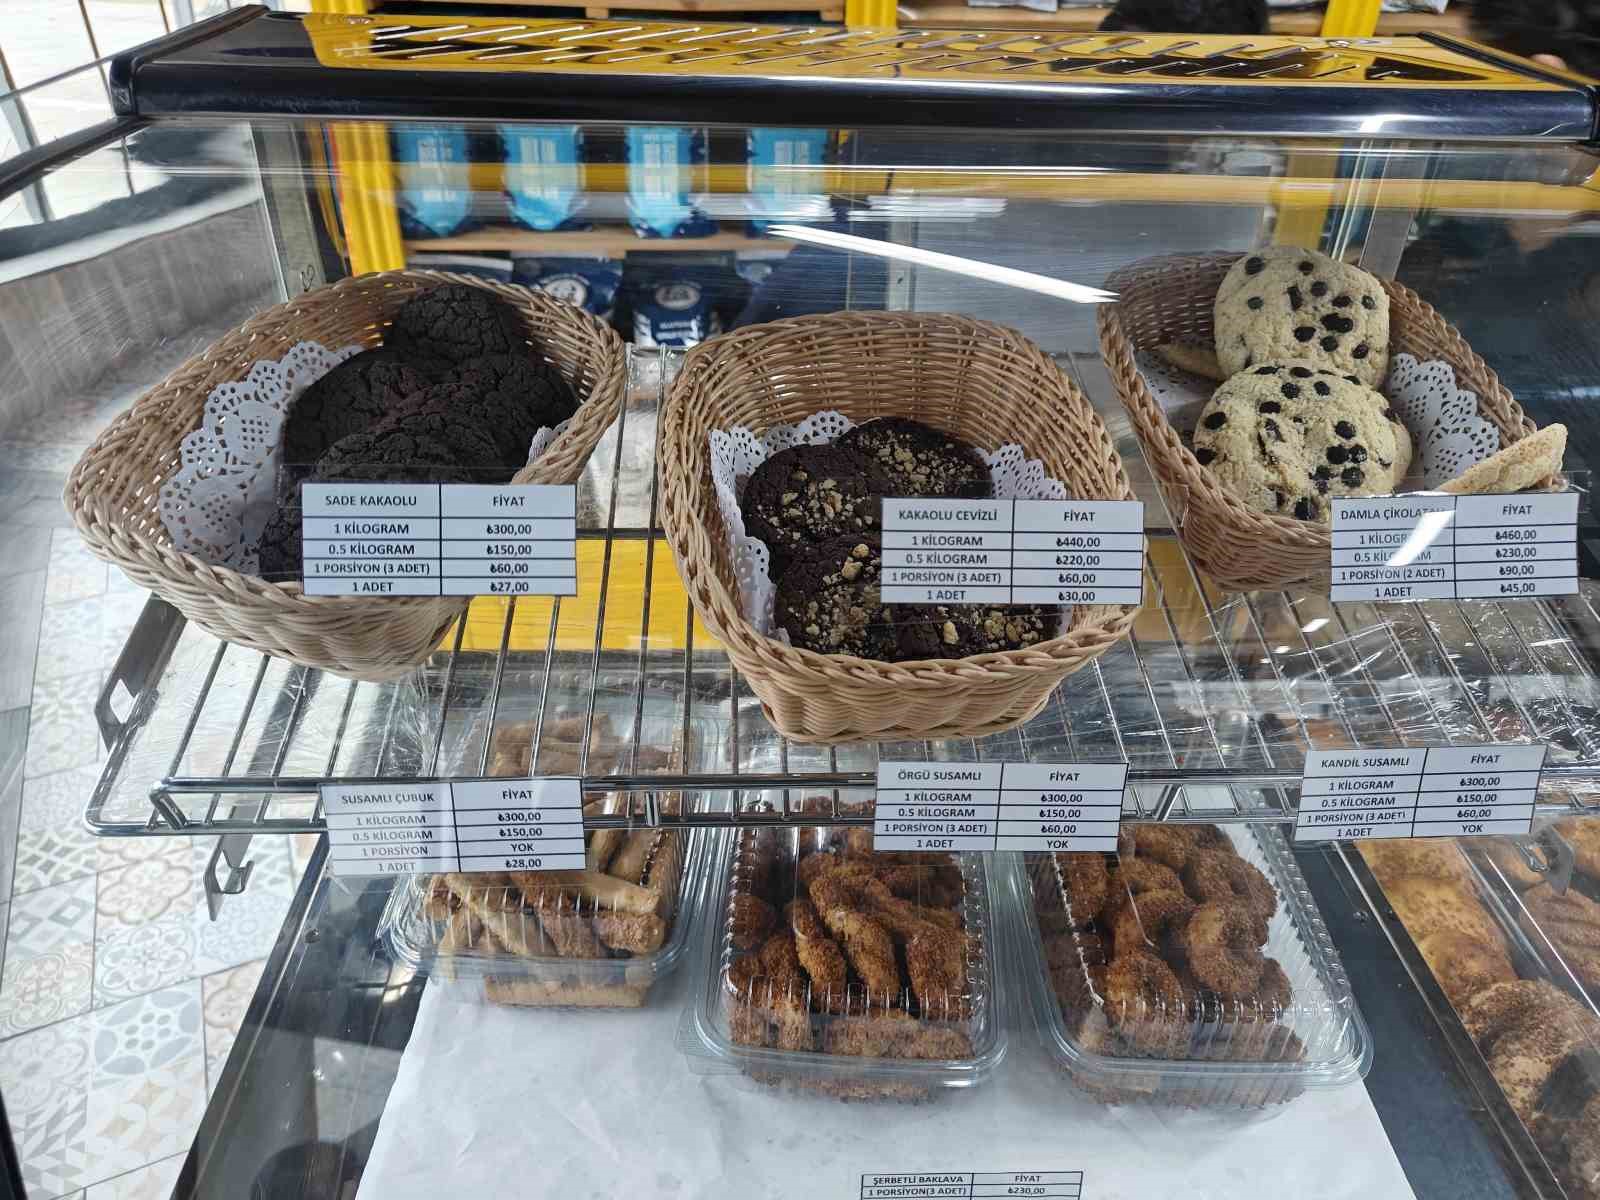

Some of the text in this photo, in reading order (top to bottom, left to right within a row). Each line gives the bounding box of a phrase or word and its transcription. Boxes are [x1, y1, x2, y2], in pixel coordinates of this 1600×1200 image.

[325, 496, 417, 507] SADE KAKAOLU
[492, 494, 525, 507] FİYAT
[899, 508, 998, 521] KAKAOLU CEVİZLİ
[1064, 509, 1096, 522] FİYAT
[1341, 507, 1446, 521] DAMLA ÇİKOLA
[1502, 504, 1532, 516] FİYAT
[334, 522, 410, 535] 1 KİLOGRAM
[486, 524, 532, 536] ₺300,00
[912, 534, 983, 546] 1 KİLOGRAM
[1360, 535, 1365, 544] 1
[1495, 530, 1537, 541] ₺460,00
[328, 542, 415, 555] 0.5 KİLOGRAM
[1056, 537, 1101, 549] ₺440,00
[486, 544, 532, 556] ₺150,00
[1496, 548, 1537, 559] ₺230,00
[906, 553, 988, 564] 0.5 KİLOGRAM
[1056, 555, 1100, 567] ₺220,00
[1354, 552, 1371, 562] 0.5
[315, 561, 430, 575] 1 PORSİYON (3 ADET)
[490, 563, 529, 575] ₺60,00
[1499, 566, 1535, 577] ₺90,00
[892, 573, 897, 582] 1
[901, 571, 954, 583] PORSİYON
[970, 573, 1001, 583] ADET)
[1059, 573, 1096, 585] ₺60,00
[1342, 571, 1347, 580] 1
[1350, 568, 1400, 580] PORSİYON
[1416, 568, 1445, 579] ADET)
[353, 582, 394, 593] 1 ADET
[490, 582, 529, 594] ₺27,00
[1375, 587, 1413, 598] 1 ADET
[1500, 584, 1536, 595] ₺45,00
[927, 590, 967, 601] 1 ADET
[1321, 757, 1409, 769] KANDİL SUSAMLI
[1470, 754, 1500, 765] FİYAT
[898, 771, 982, 781] ÖRGÜ SUSAMLI
[1050, 771, 1080, 782] FİYAT
[1329, 779, 1394, 791] 1 KİLOGRAM
[341, 794, 393, 805] SUSAMLI
[502, 788, 534, 801] FİYAT
[904, 791, 972, 802] 1 KİLOGRAM
[1041, 794, 1083, 804] ₺300,00
[1322, 797, 1396, 808] 0.5 KİLOGRAM
[498, 812, 541, 823] ₺300,00
[898, 806, 976, 818] 0.5 KİLOGRAM
[1039, 809, 1081, 819] ₺150,00
[1308, 815, 1312, 823] 1
[1315, 812, 1364, 823] PORSİYON
[356, 813, 427, 826] 1 KİLOGRAM
[500, 827, 543, 838] ₺150,00
[884, 824, 890, 833] 1
[893, 823, 944, 833] PORSİYON
[957, 824, 988, 834] ADET)
[1337, 828, 1373, 838] 1 ADET
[1462, 824, 1483, 834] YOK
[353, 829, 433, 842] 0.5 KİLOGRAM
[511, 843, 535, 853] YOK
[917, 839, 954, 849] 1 ADET
[1047, 840, 1068, 849] YOK
[371, 845, 429, 856] PORSİYON
[389, 862, 416, 871] ADET
[506, 858, 542, 869] ₺28,00
[919, 1176, 964, 1184] BAKLAVA
[1015, 1174, 1042, 1183] FİYAT
[869, 1189, 875, 1197] 1
